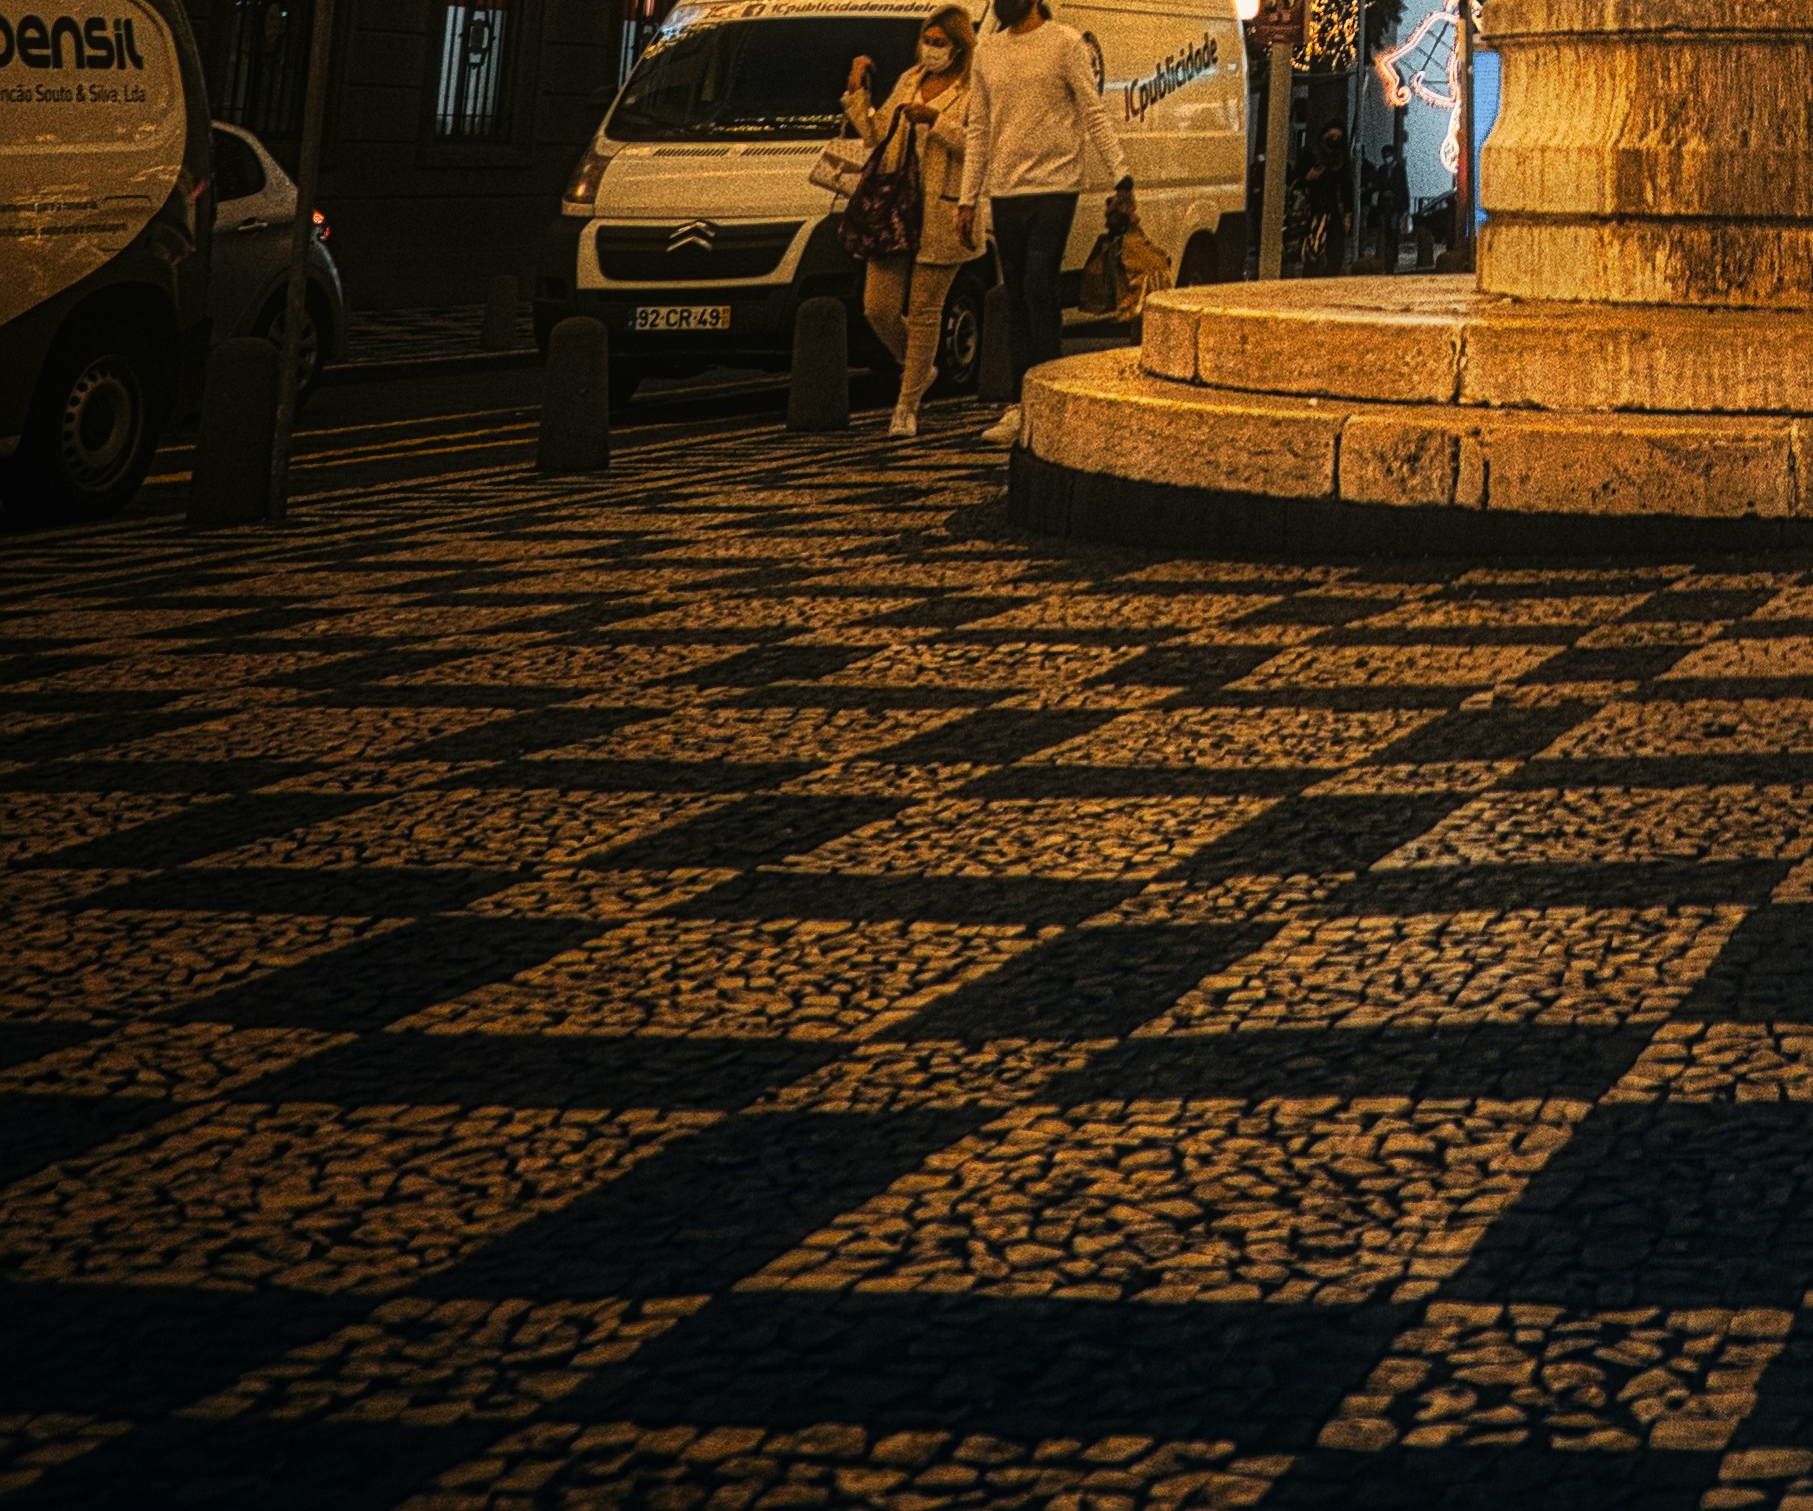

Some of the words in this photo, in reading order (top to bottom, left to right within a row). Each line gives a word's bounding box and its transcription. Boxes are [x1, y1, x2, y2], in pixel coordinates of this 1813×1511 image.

[770, 1, 939, 15] ICpublicidademadeir
[1124, 32, 1218, 123] ICpublicidade
[76, 84, 86, 102] &
[638, 309, 721, 328] 92-CR-49
